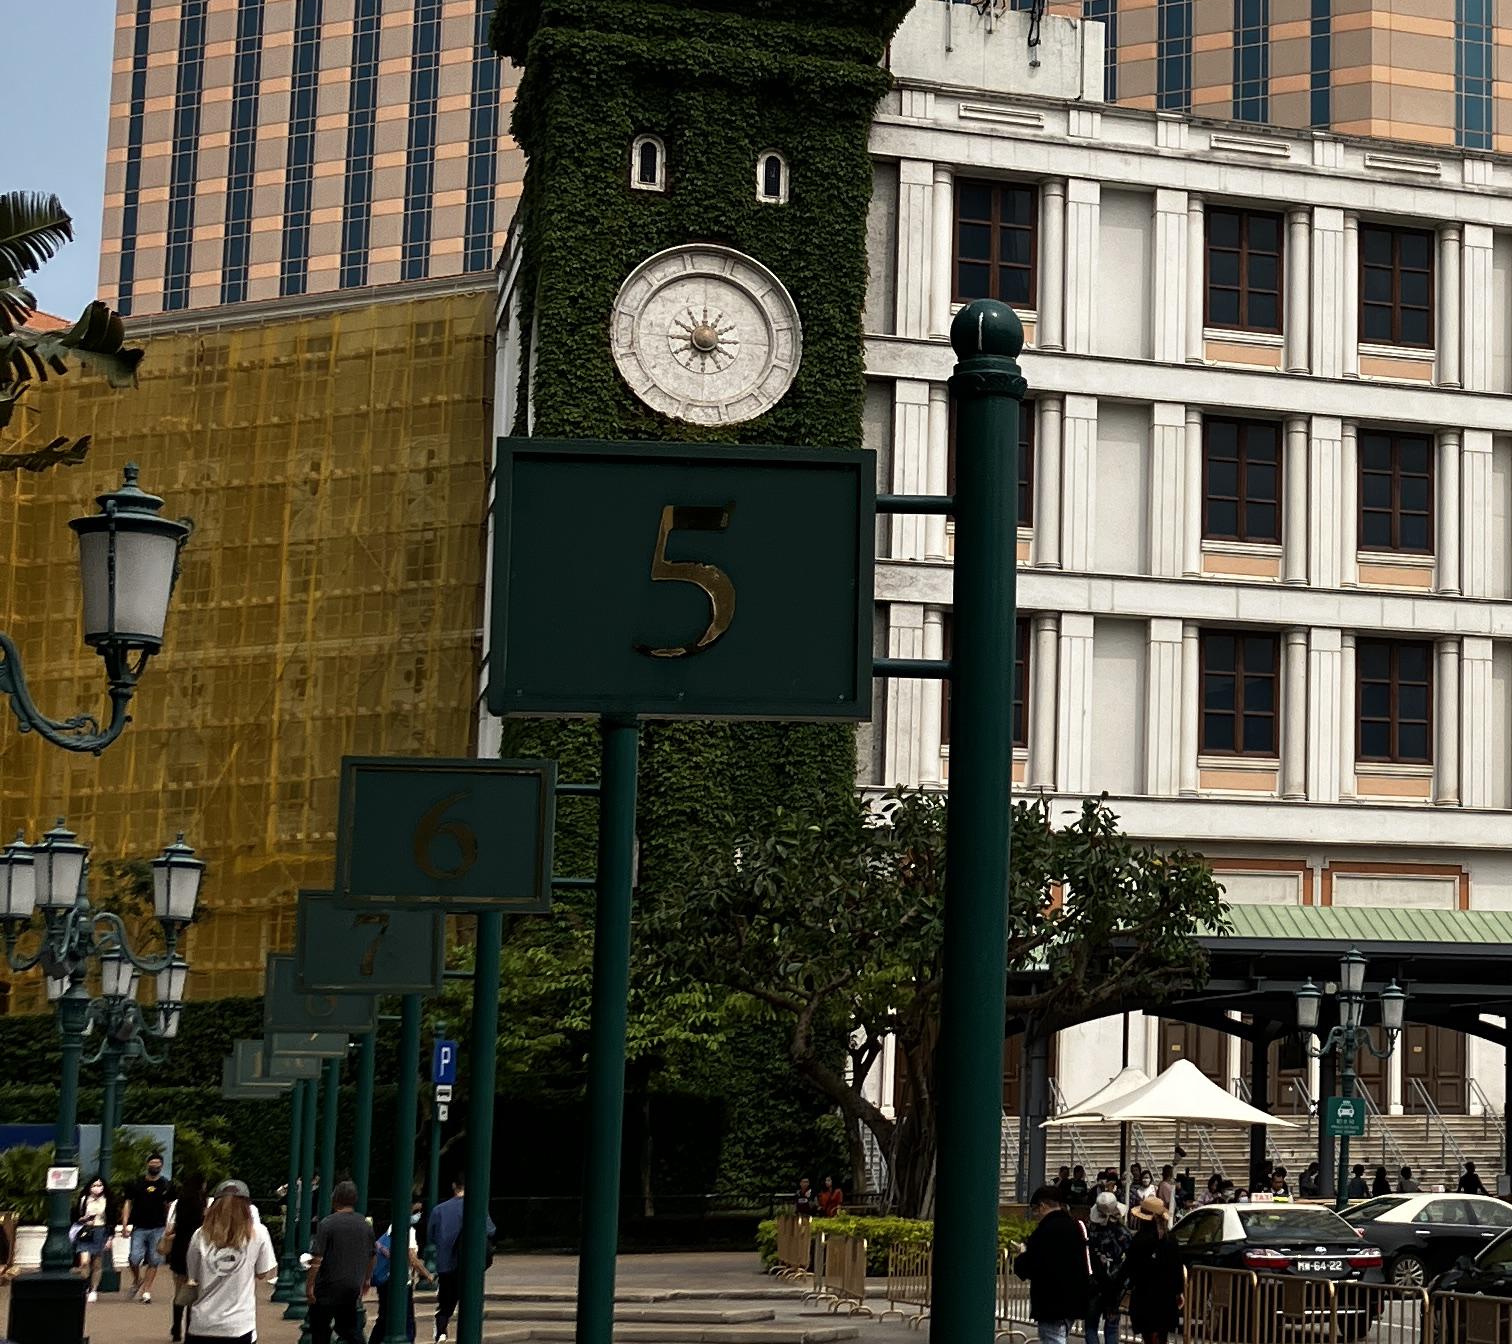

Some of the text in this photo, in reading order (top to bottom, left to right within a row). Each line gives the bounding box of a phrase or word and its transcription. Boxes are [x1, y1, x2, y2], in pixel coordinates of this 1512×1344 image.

[632, 501, 736, 658] 5
[414, 791, 478, 880] 6
[350, 914, 391, 976] 7
[440, 1046, 451, 1077] P
